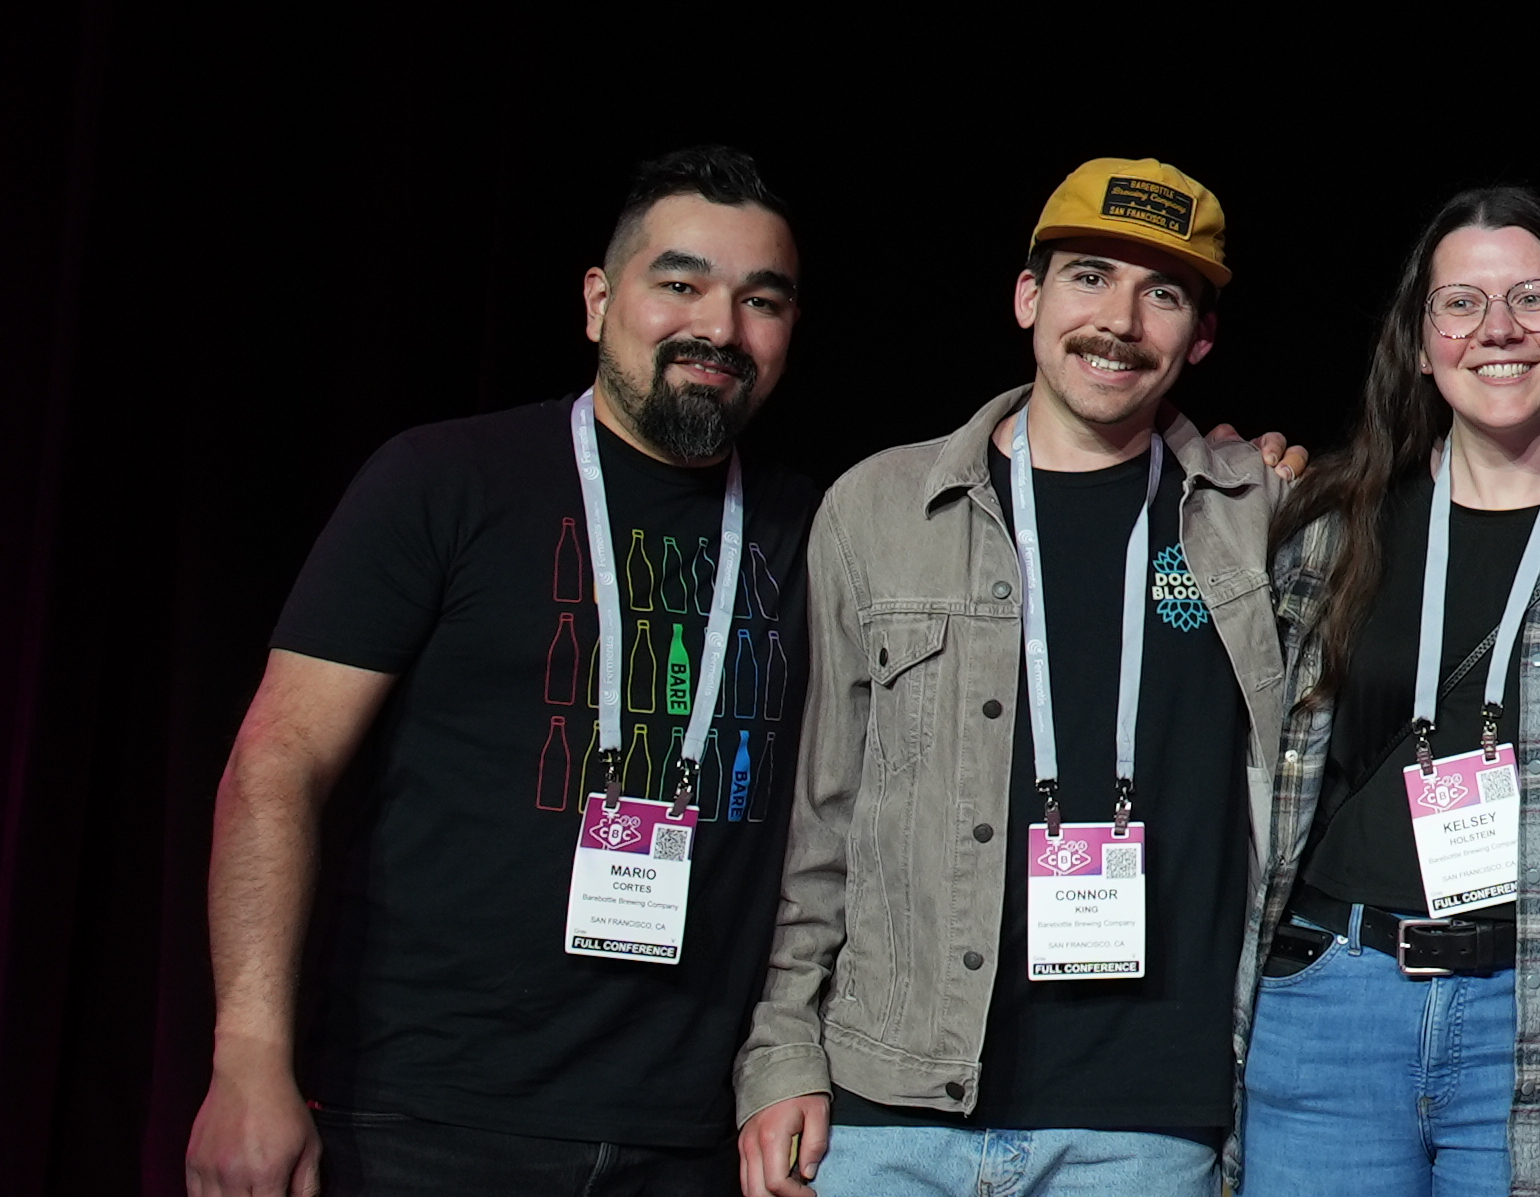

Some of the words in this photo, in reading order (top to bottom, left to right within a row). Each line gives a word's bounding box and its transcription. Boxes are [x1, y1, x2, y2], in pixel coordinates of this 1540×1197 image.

[1130, 180, 1174, 199] BAREBOTTLE
[1111, 186, 1148, 201] Brewing
[1150, 194, 1187, 214] Company
[1109, 206, 1125, 215] SAN
[1169, 220, 1180, 232] CA
[1155, 572, 1195, 586] DOO
[1152, 586, 1200, 600] BLOO
[604, 635, 614, 684] Fermentis
[704, 651, 719, 697] Fermentis
[670, 663, 687, 712] BARE
[1034, 659, 1047, 707] Fermentis
[731, 770, 748, 818] BARE
[1443, 812, 1497, 834] KELSEY
[1450, 829, 1496, 846] HOLSTEIN
[610, 865, 657, 880] MARIO
[1443, 872, 1458, 882] SAN
[613, 882, 652, 893] CORTES
[1056, 889, 1118, 901] CONNOR
[619, 897, 646, 908] Brewing
[648, 901, 679, 911] Company
[1434, 896, 1461, 910] FULL
[1463, 882, 1517, 902] CONFEREN
[1075, 906, 1098, 914] KING
[590, 916, 606, 925] SAN
[656, 923, 666, 931] CA
[1104, 920, 1136, 928] Company
[574, 937, 601, 950] FULL
[603, 940, 675, 957] CONFERENCE
[1114, 940, 1125, 948] CA
[1035, 964, 1062, 974] FULL
[1064, 962, 1137, 974] CONFERENCE
